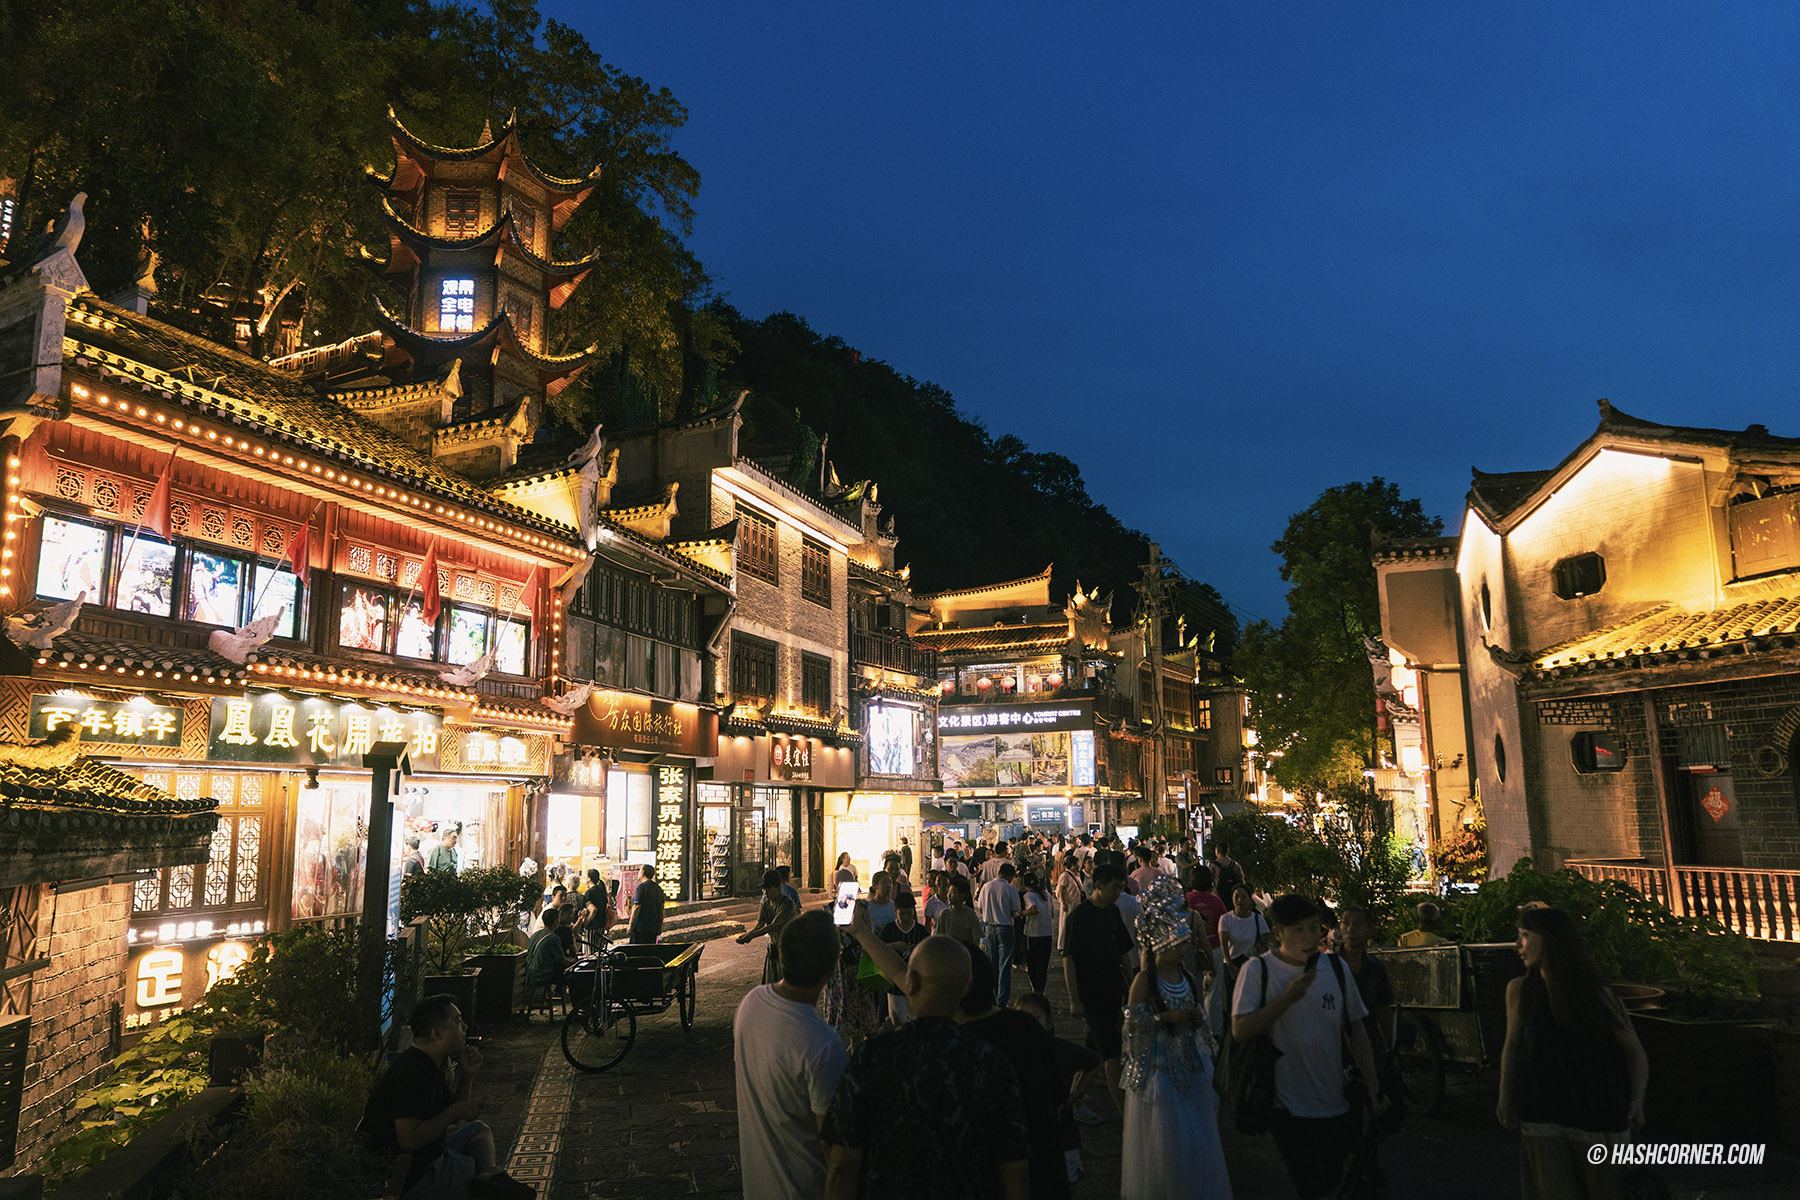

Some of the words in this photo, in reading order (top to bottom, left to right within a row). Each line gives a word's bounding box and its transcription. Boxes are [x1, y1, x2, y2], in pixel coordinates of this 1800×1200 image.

[218, 700, 437, 758] 鳳凰花開旅拍
[784, 744, 809, 767] 美宜佳
[656, 767, 684, 900] 张家界旅游接待
